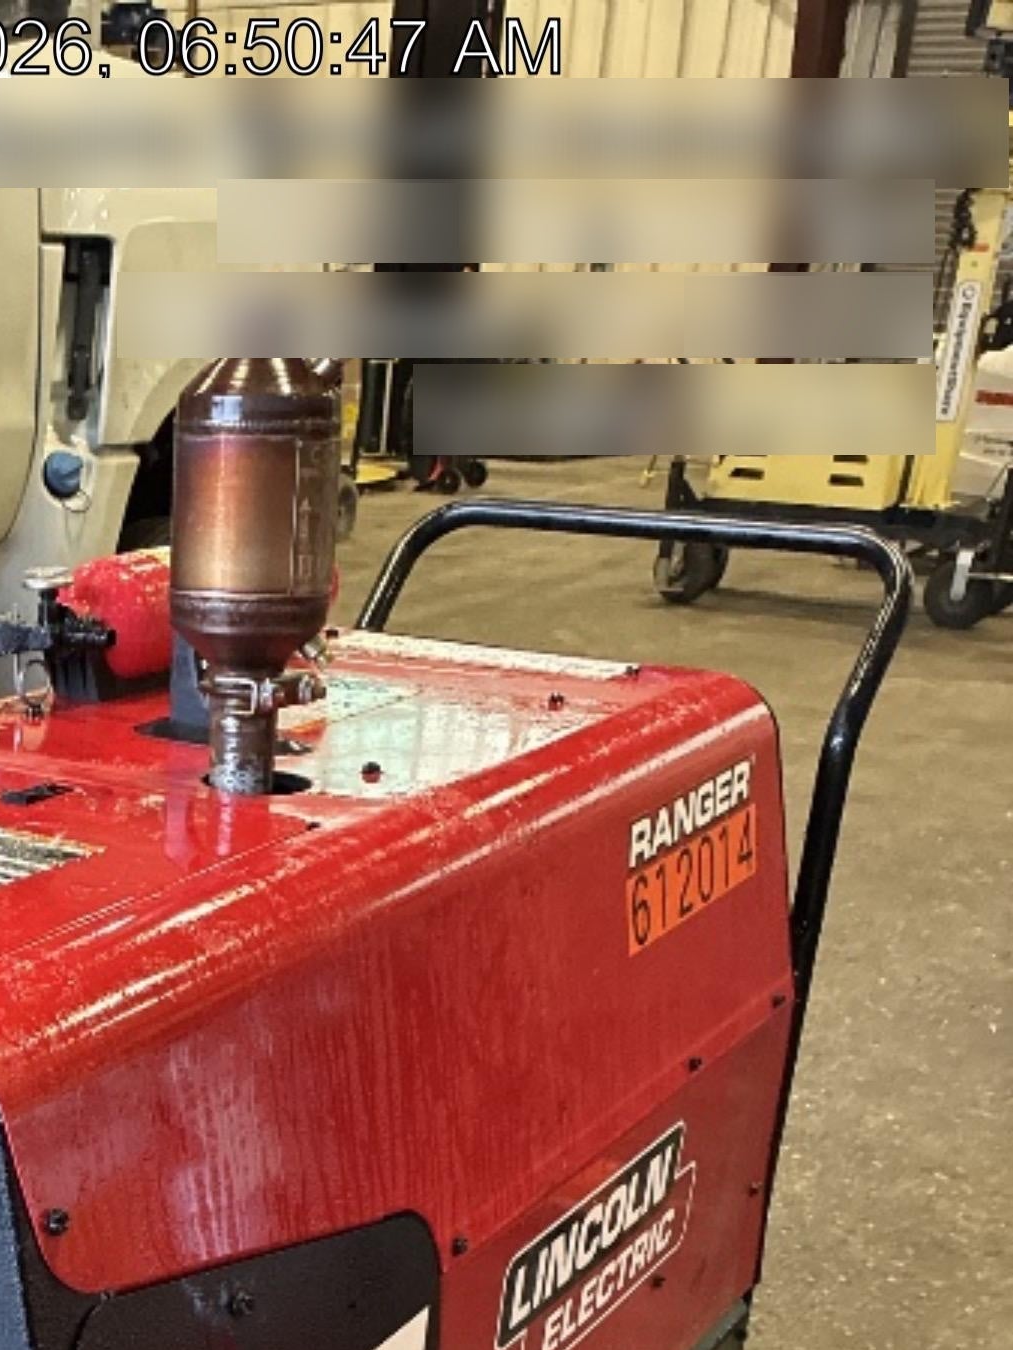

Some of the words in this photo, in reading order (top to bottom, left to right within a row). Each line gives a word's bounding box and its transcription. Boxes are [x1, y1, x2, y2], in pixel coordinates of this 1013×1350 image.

[629, 761, 751, 868] RANGER
[632, 811, 754, 945] 612014
[508, 1143, 675, 1330] LINCOLN
